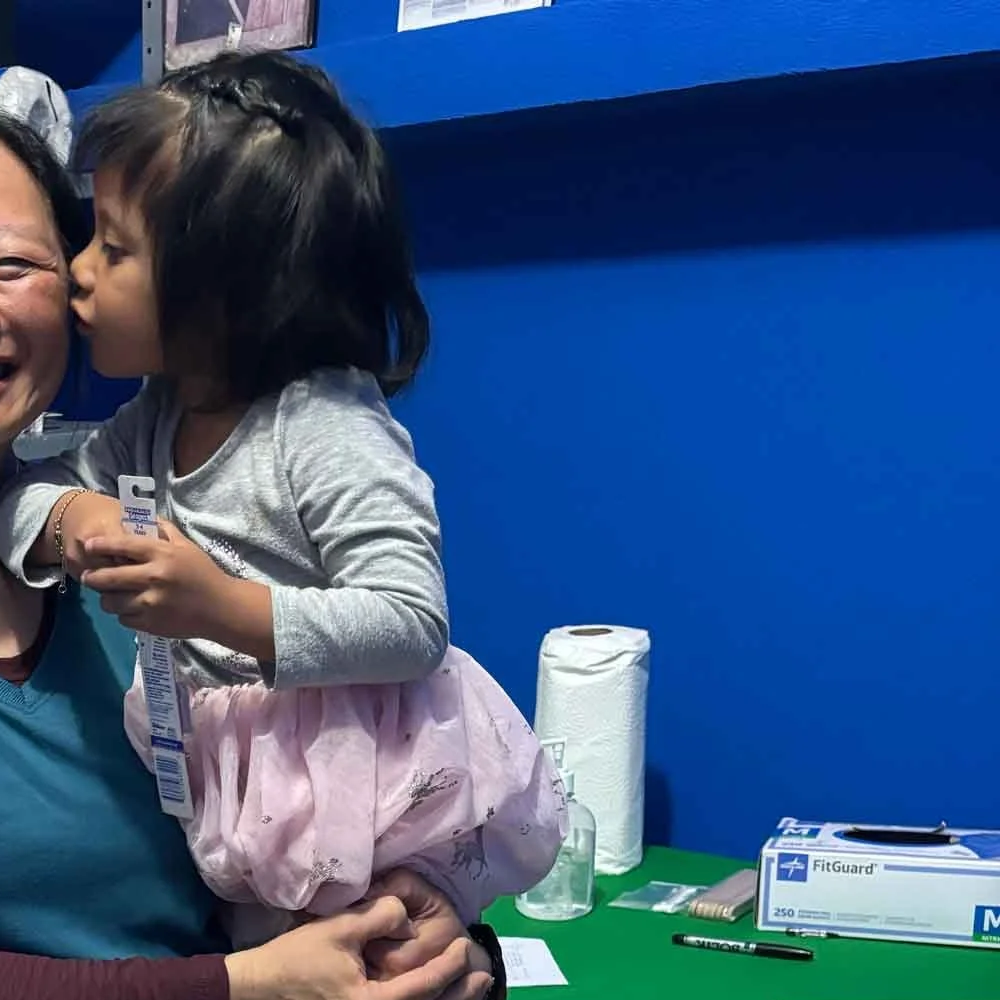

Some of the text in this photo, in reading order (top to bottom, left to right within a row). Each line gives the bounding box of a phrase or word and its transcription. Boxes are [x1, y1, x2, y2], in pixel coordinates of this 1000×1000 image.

[812, 859, 874, 876] FitGuard
[773, 907, 796, 918] 250
[983, 908, 1000, 932] M
